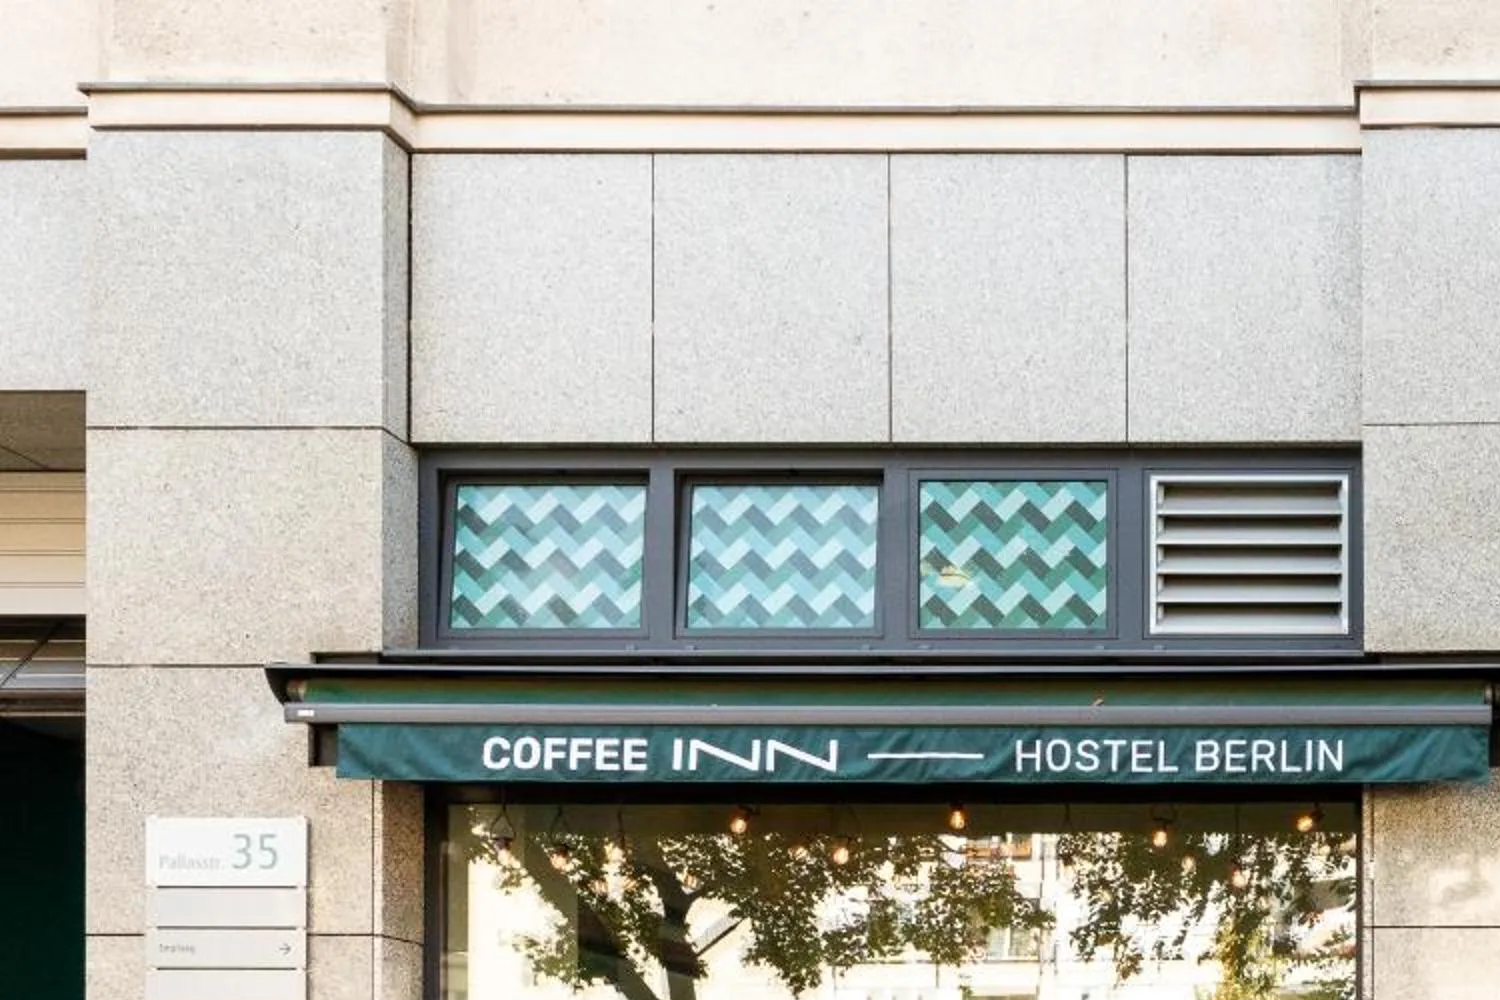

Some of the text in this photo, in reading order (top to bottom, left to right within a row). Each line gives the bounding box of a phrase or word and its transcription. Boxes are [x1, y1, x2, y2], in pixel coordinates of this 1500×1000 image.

[482, 736, 1343, 773] COFFEE INN HOSTEL BERLIN
[231, 833, 279, 870] 35
